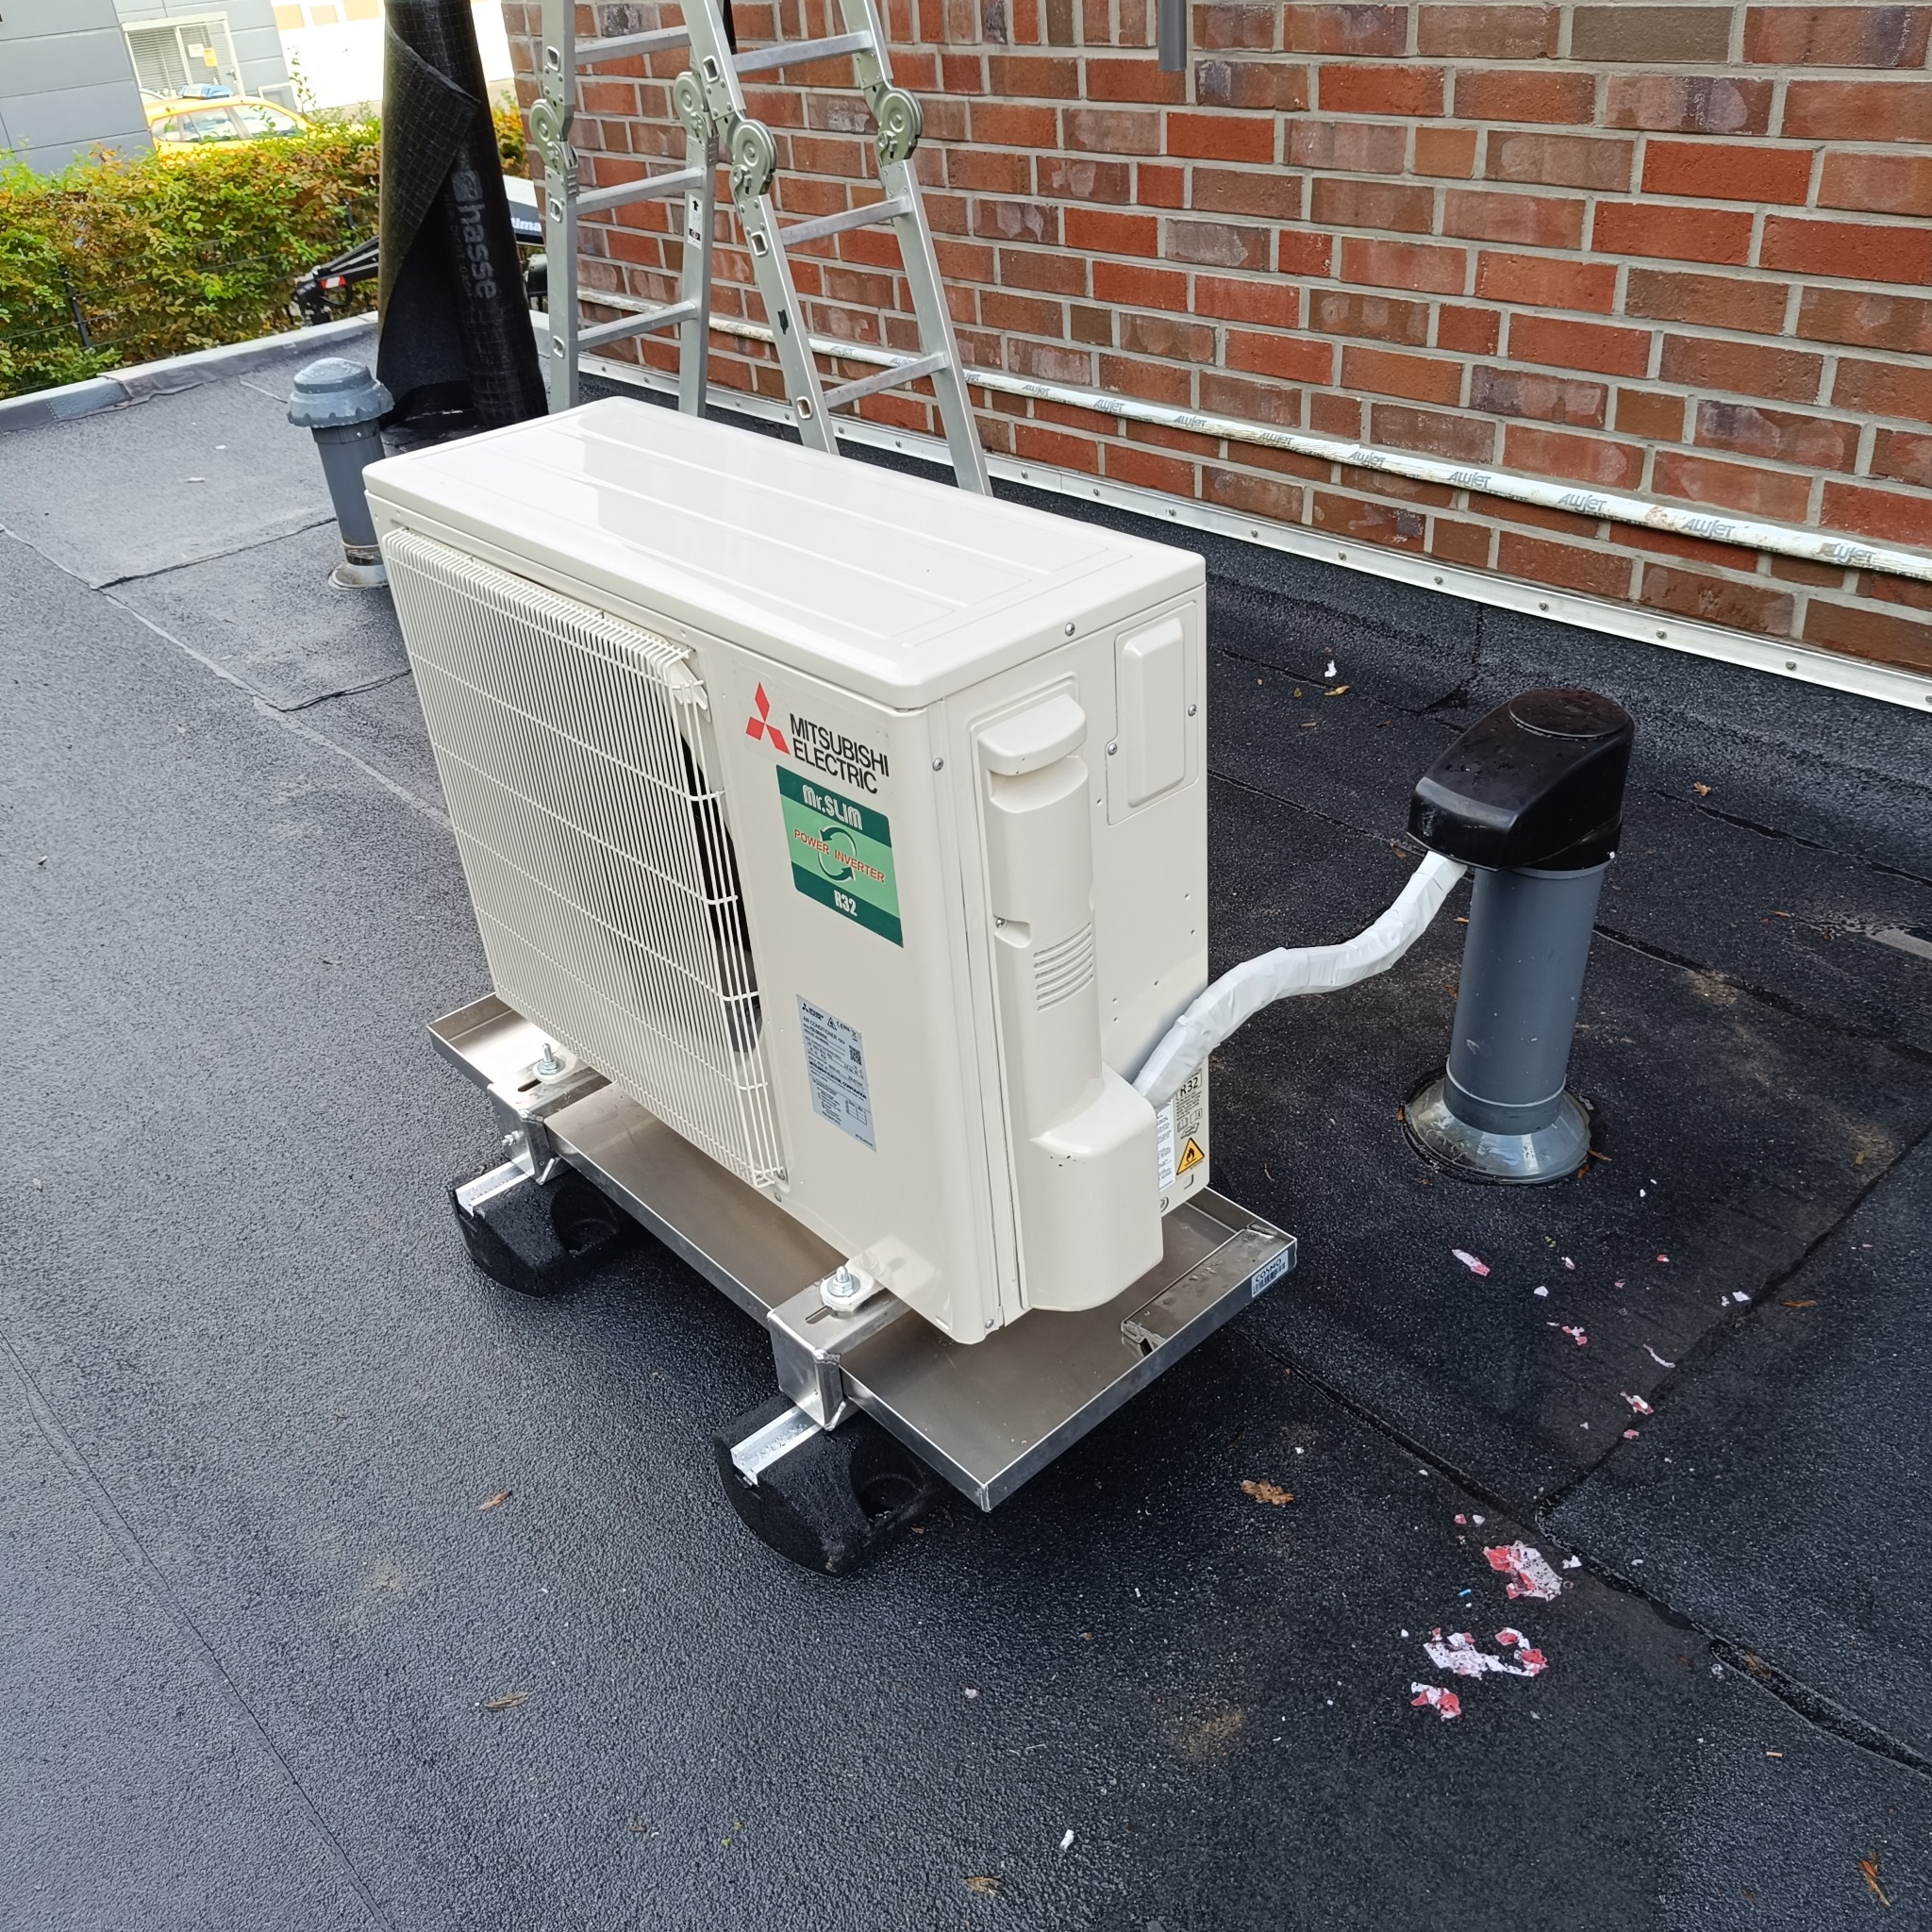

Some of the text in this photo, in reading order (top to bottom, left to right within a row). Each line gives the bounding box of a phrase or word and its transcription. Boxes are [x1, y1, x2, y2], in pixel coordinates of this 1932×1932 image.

[457, 203, 497, 299] hasse
[789, 712, 890, 777] MITSUBISHI
[792, 740, 878, 794] ELECTRIC
[794, 829, 885, 883] POWER INVERTER
[833, 890, 858, 917] R32
[1180, 1076, 1198, 1096] R32
